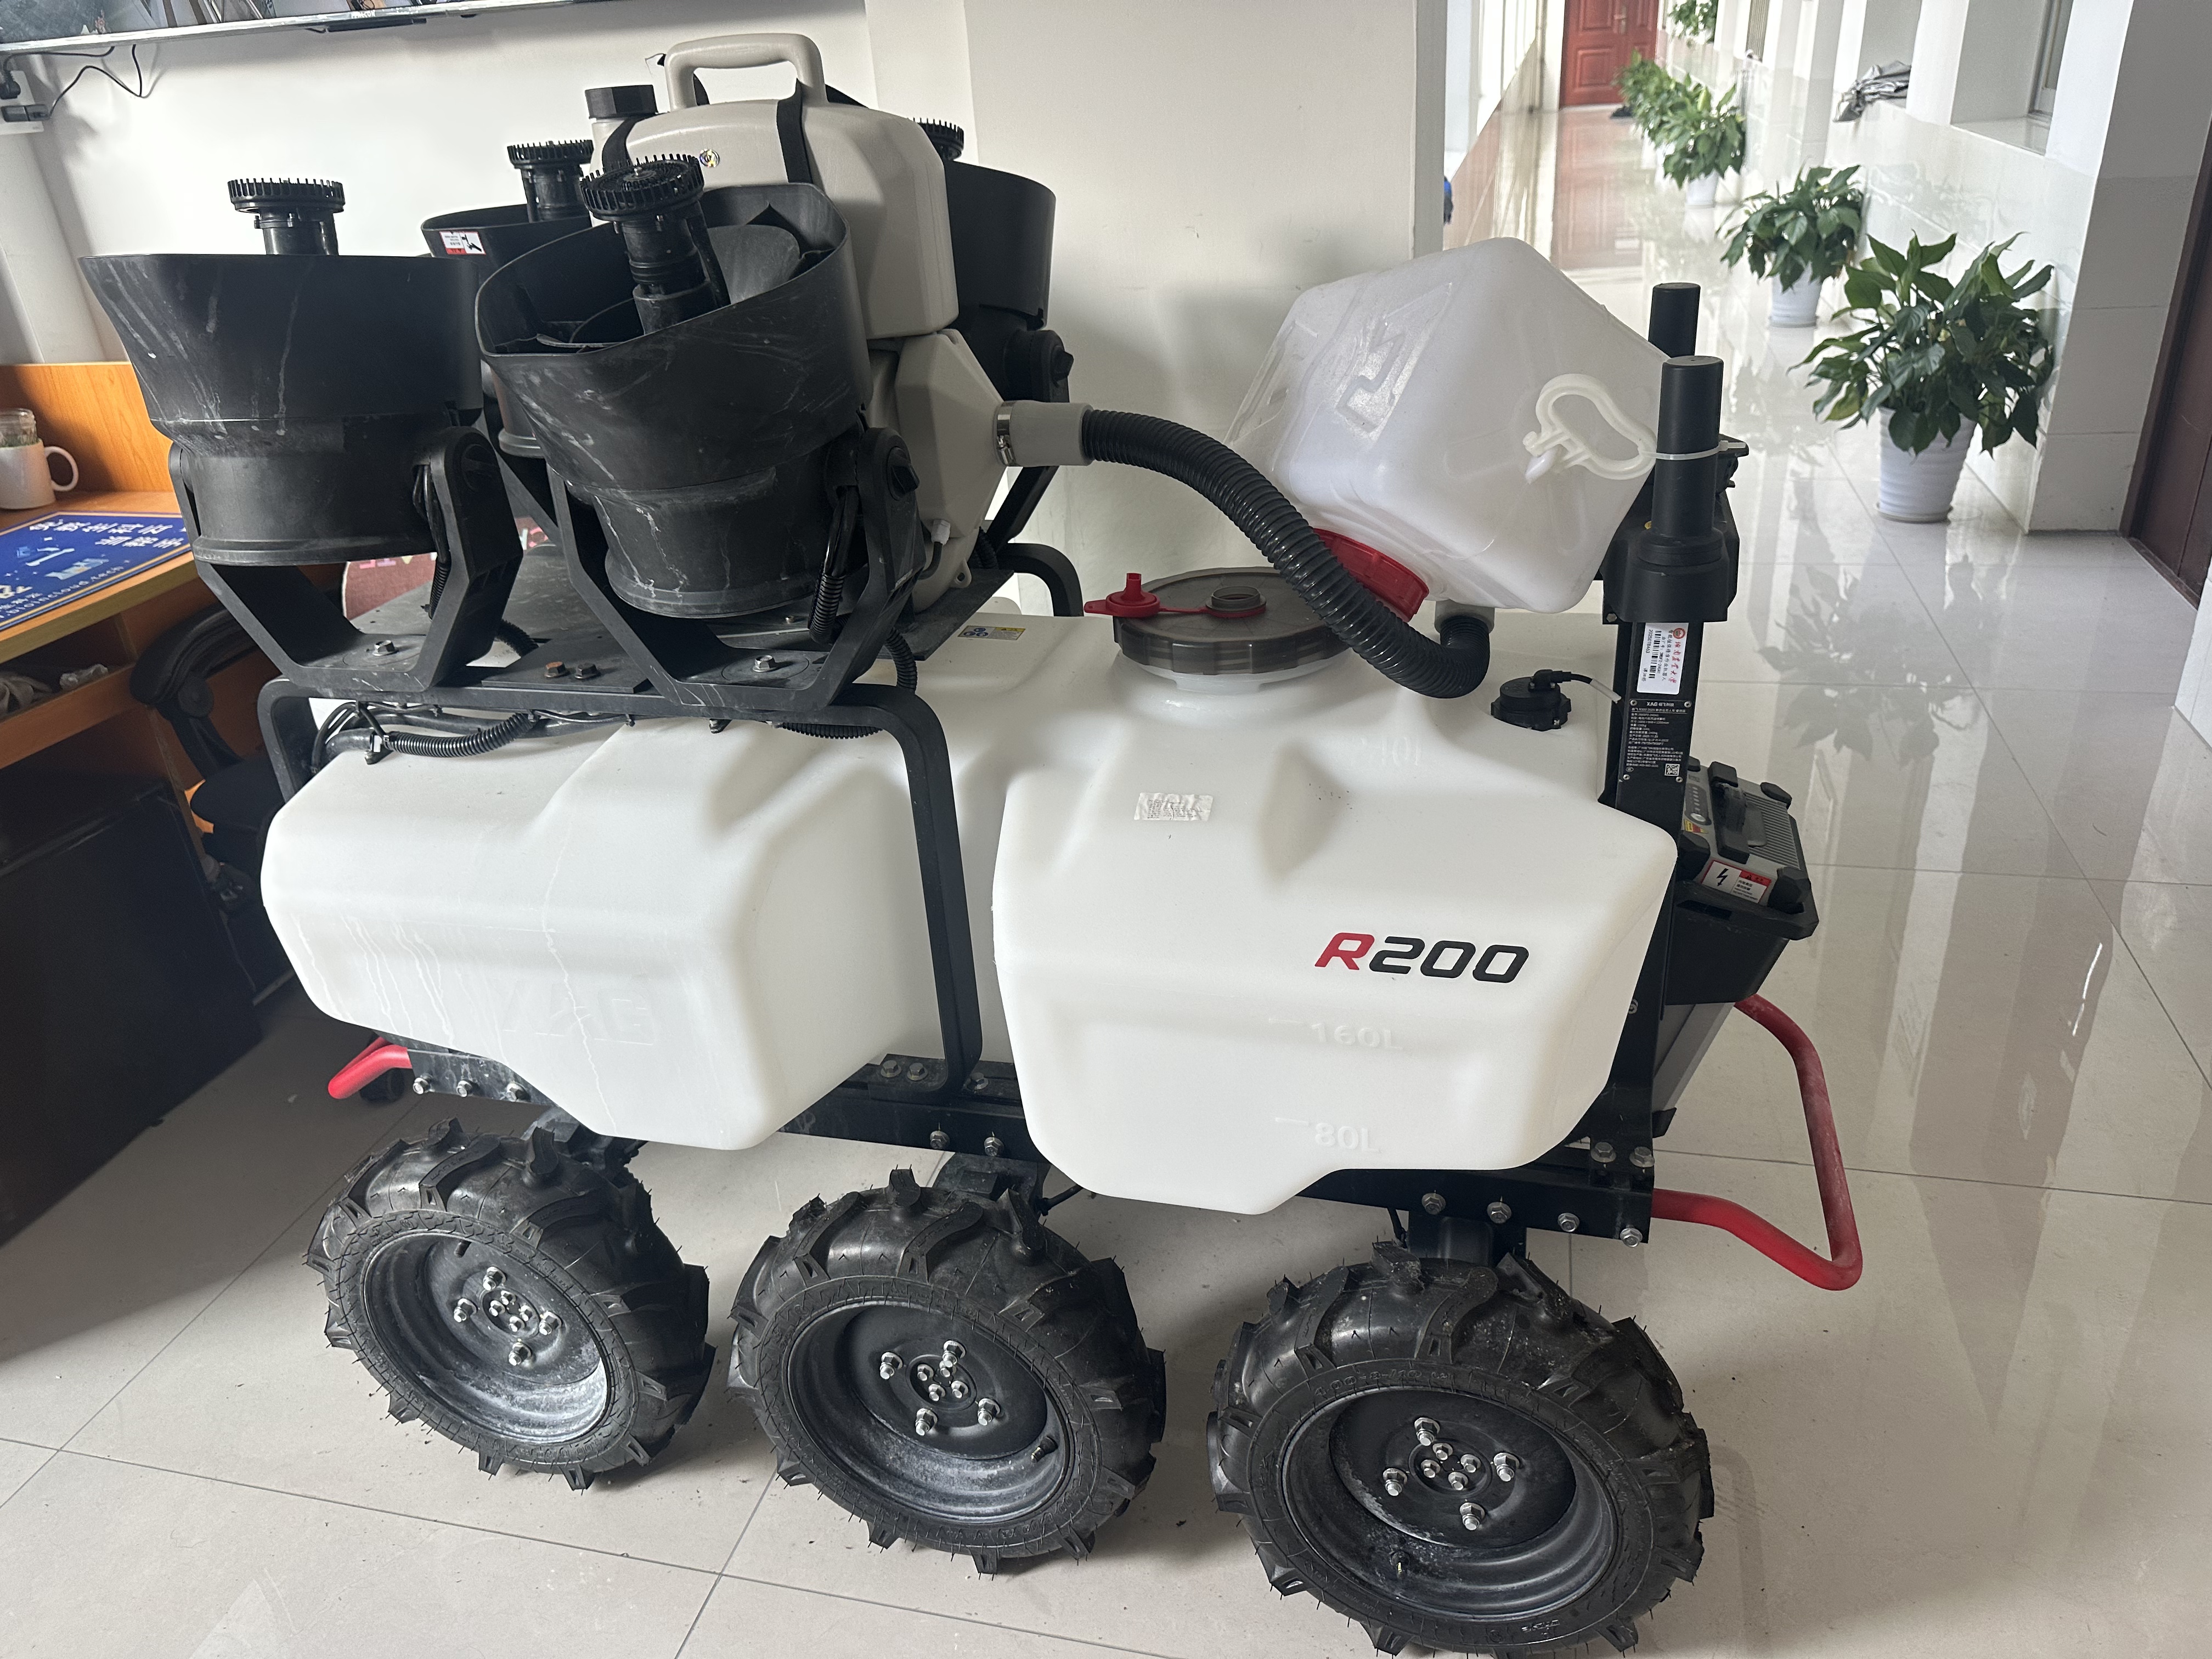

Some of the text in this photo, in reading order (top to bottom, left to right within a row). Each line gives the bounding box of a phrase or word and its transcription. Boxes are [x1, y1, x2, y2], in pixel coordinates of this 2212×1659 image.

[1314, 932, 1529, 983] R200
[1311, 1023, 1403, 1051] 160L
[1314, 1122, 1384, 1153] 80L
